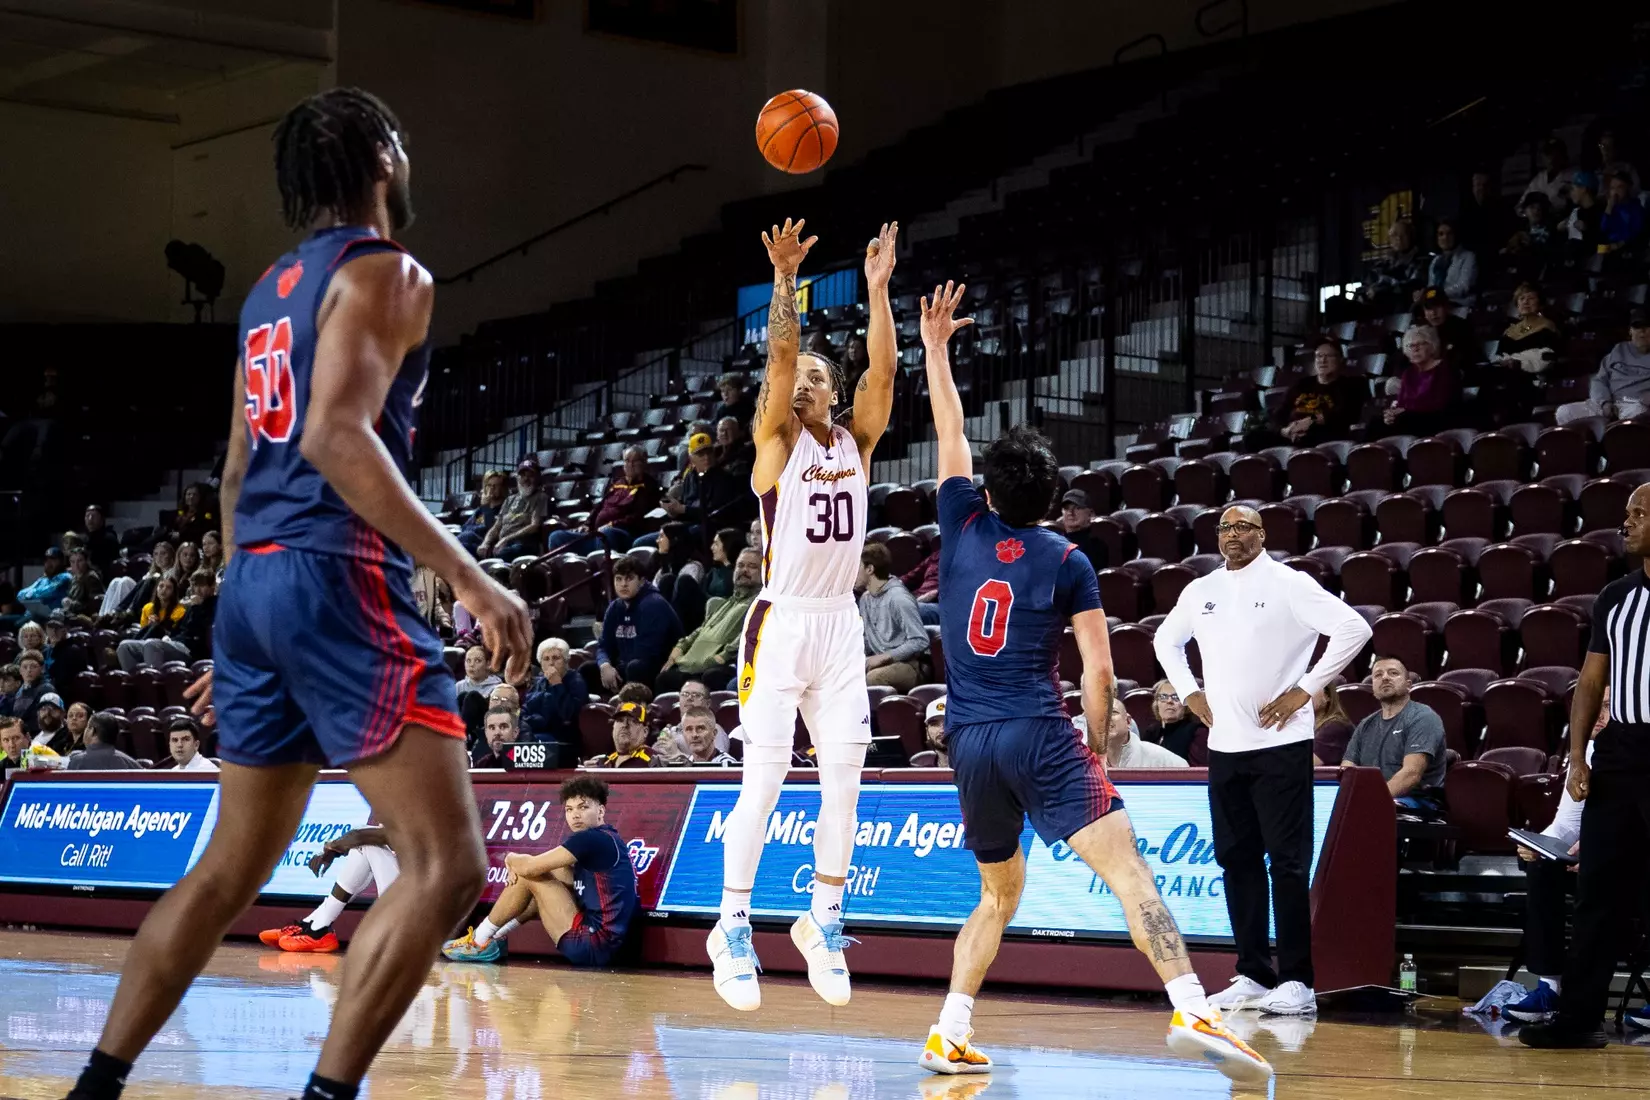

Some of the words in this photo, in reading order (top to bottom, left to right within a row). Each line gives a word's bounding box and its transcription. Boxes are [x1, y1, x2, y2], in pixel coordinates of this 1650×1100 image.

[801, 463, 857, 486] Chippwas
[806, 491, 854, 544] 30
[967, 578, 1014, 657] 0
[513, 745, 546, 762] POSS
[14, 803, 125, 838] Mid-Michigan
[123, 804, 192, 840] Agency
[486, 800, 551, 841] 7:36
[61, 844, 86, 867] Call
[86, 845, 114, 868] Rit!
[487, 866, 509, 883] OUL
[845, 865, 880, 896] Rit!
[1032, 928, 1075, 937] DAKTRONICS
